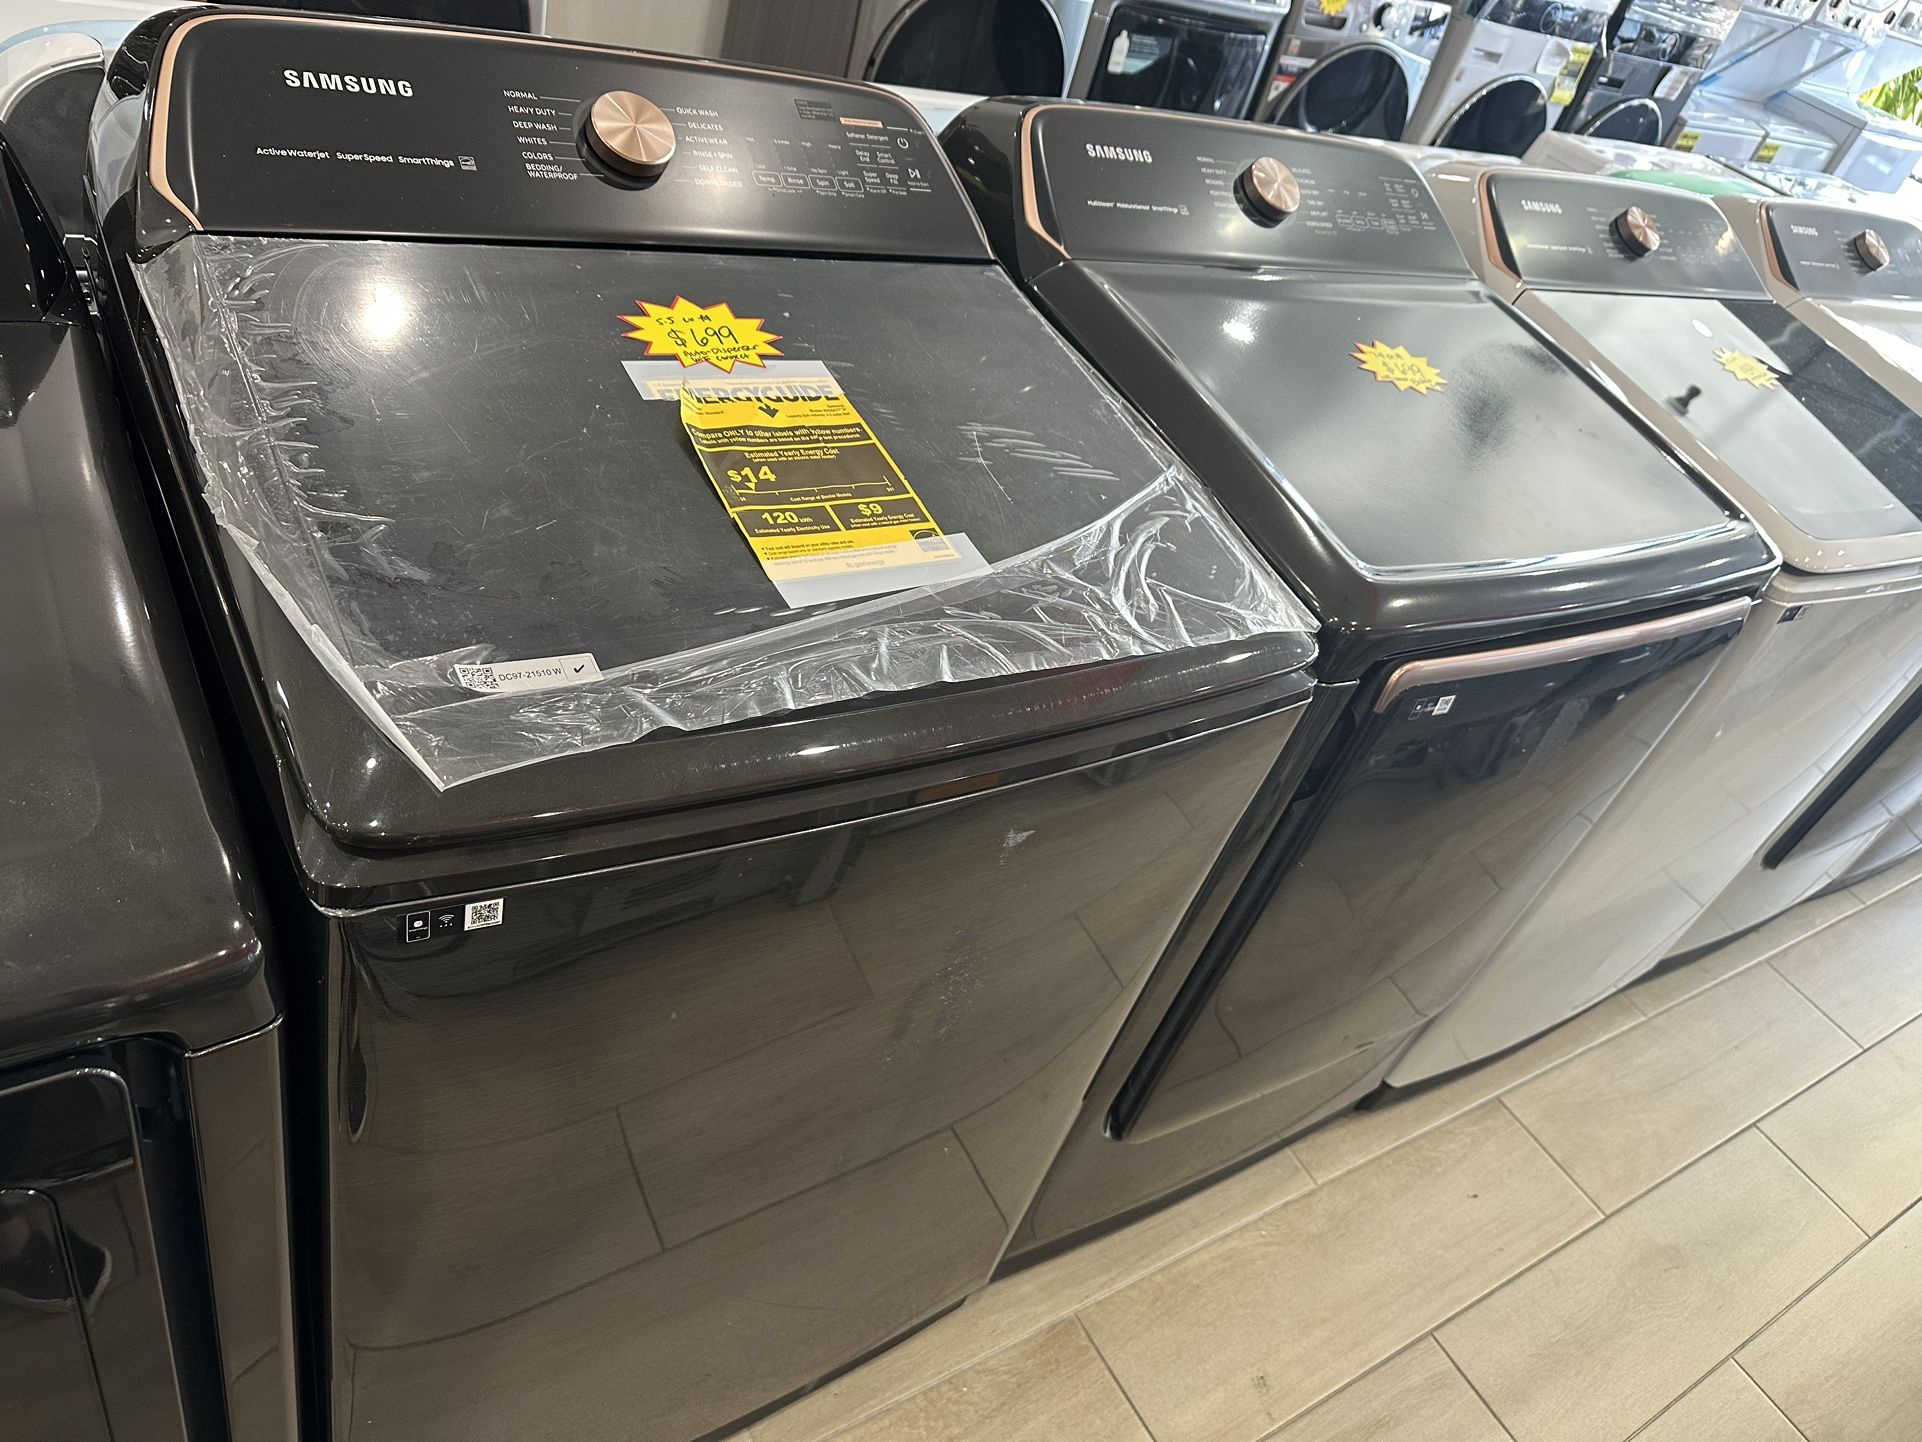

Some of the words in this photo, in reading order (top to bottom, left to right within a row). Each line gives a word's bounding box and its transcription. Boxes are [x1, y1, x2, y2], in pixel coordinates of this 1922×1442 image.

[283, 69, 414, 97] SAMSUNG
[503, 90, 538, 100] NORMAL
[508, 105, 535, 115] HEAVY
[535, 108, 556, 116] DUTY
[676, 106, 698, 115] QUICK
[698, 109, 719, 117] WASH
[512, 121, 537, 130] DEEP
[537, 123, 558, 131] WASH
[687, 122, 724, 131] DELICATES
[517, 136, 548, 145] WHITES
[685, 136, 729, 145] ACTIVEWEAR
[522, 151, 554, 161] COLORS
[1085, 143, 1153, 163] SAMSUNG
[398, 156, 455, 168] SmartThings
[525, 163, 563, 172] BEDDING/
[527, 170, 578, 181] WATERPROOF
[1521, 199, 1562, 214] SAMSUNG
[667, 325, 740, 348] $699
[691, 427, 723, 440] Compare
[723, 429, 745, 438] ONLY
[754, 429, 772, 438] other
[772, 430, 794, 438] labels
[793, 428, 810, 436] with
[831, 427, 863, 435] numbers.
[744, 450, 778, 459] Estimated
[778, 450, 800, 458] Yearly
[800, 448, 823, 457] Energy
[823, 447, 840, 455] Cost
[726, 465, 777, 484] $14
[857, 503, 883, 516] $9
[761, 510, 799, 525] 120
[799, 516, 814, 524] kWh
[755, 527, 779, 535] Estimated
[779, 526, 796, 534] Yearly
[795, 525, 820, 533] Electricity
[498, 668, 552, 682] DC97-21510
[553, 668, 563, 676] W
